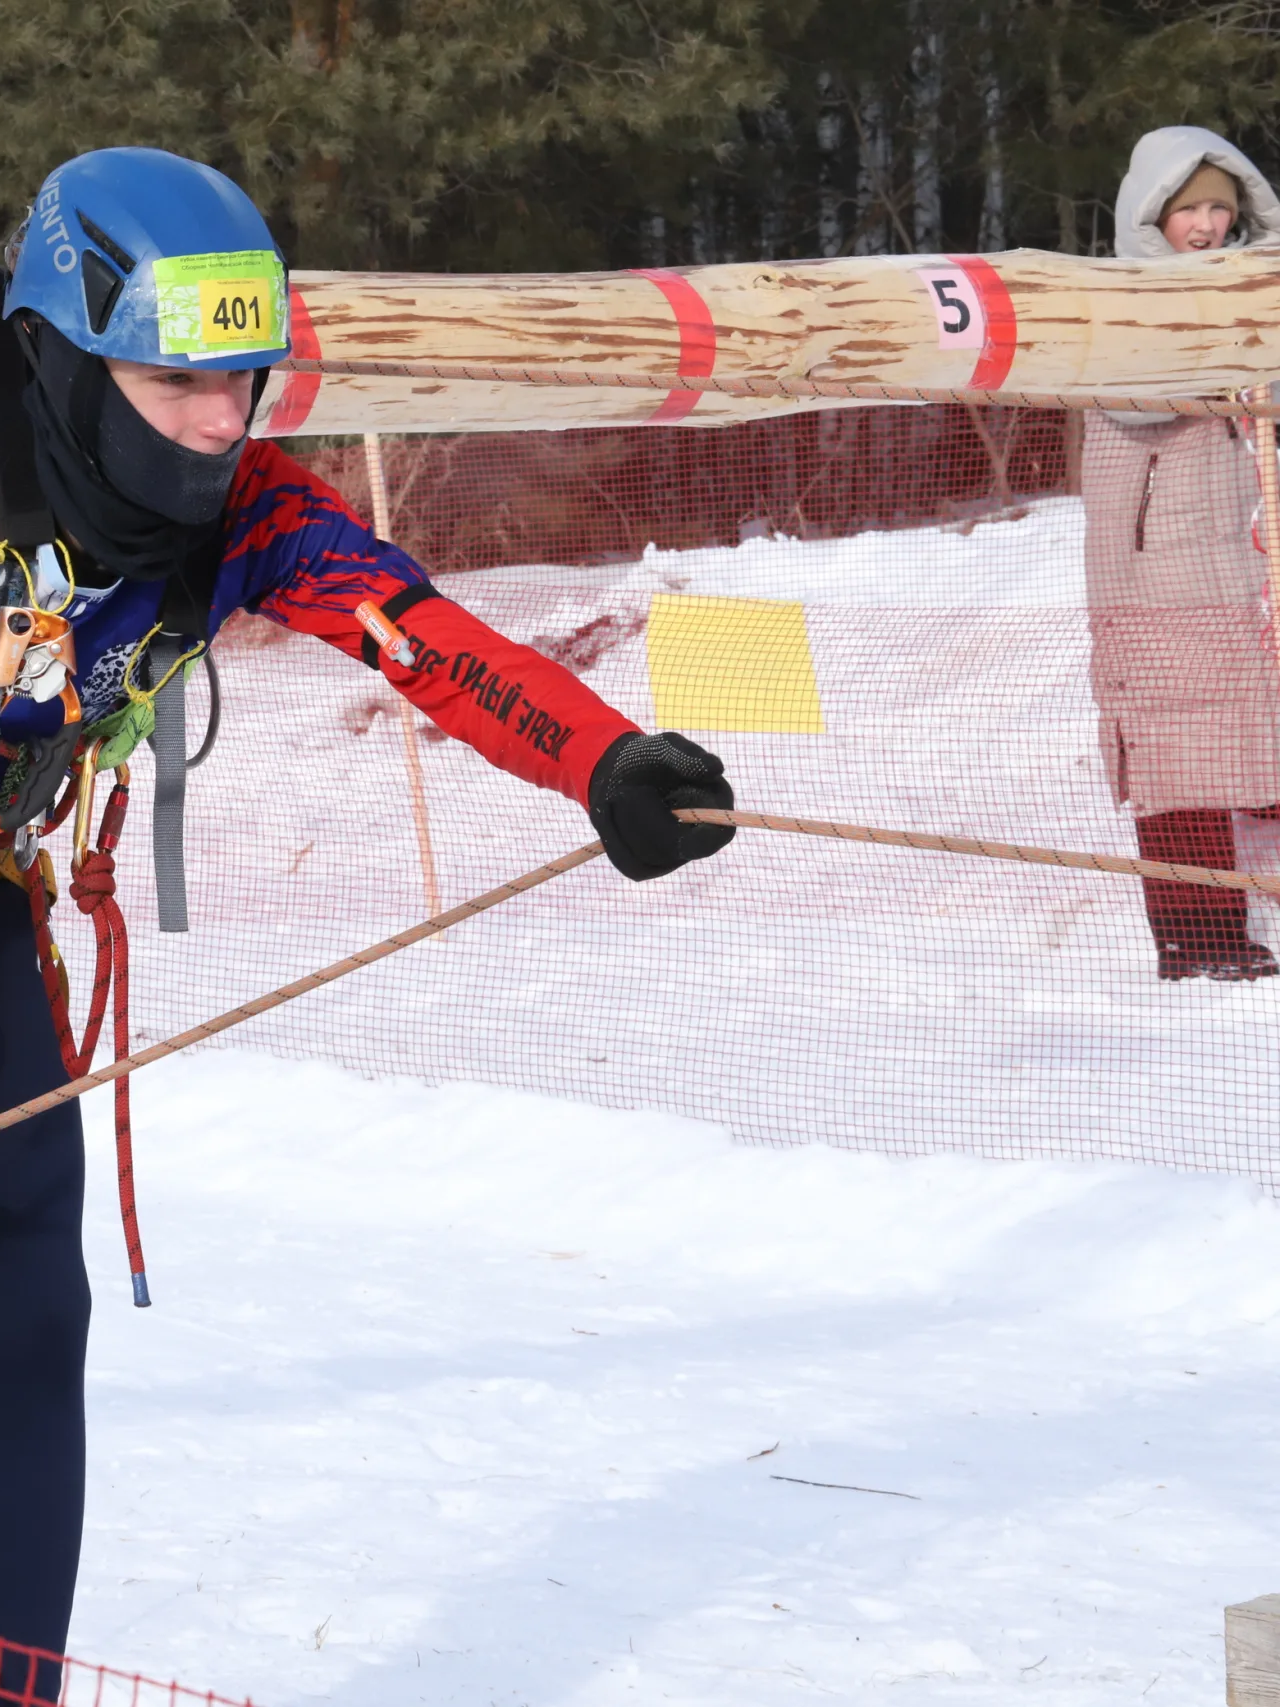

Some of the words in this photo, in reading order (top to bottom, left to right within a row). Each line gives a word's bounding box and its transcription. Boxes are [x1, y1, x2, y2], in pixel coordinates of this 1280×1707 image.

[39, 171, 78, 273] VENTO
[213, 296, 260, 331] 401
[931, 279, 971, 334] 5
